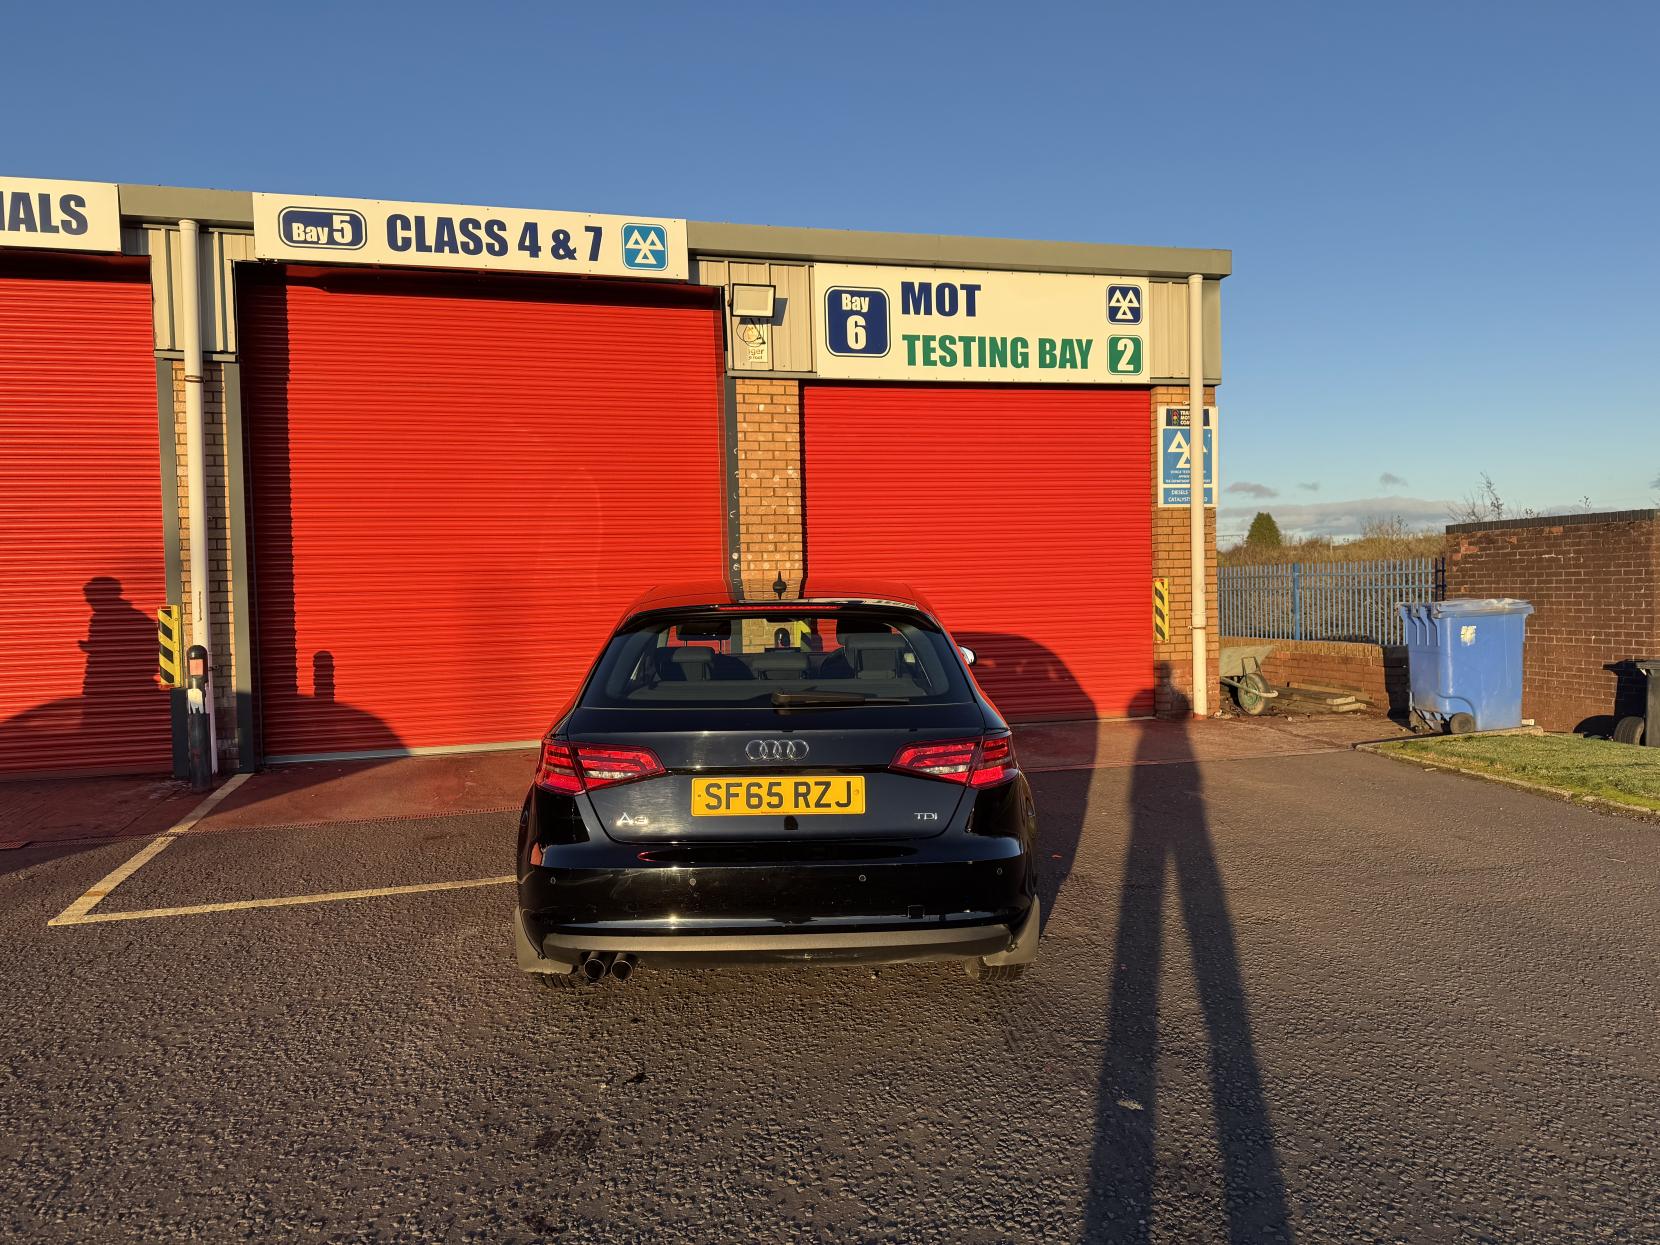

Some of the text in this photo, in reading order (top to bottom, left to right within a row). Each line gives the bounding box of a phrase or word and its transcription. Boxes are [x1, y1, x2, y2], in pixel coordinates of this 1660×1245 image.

[291, 214, 353, 244] Bay 5
[386, 213, 603, 262] CLASS 4 & 7
[842, 293, 869, 313] Bay
[901, 281, 981, 317] MOT
[846, 315, 867, 350] 6
[902, 334, 1093, 370] TESTING BAY
[1117, 338, 1135, 371] 2
[704, 780, 852, 810] SF65 RZJ
[616, 812, 648, 826] A3
[914, 812, 938, 820] TDI
